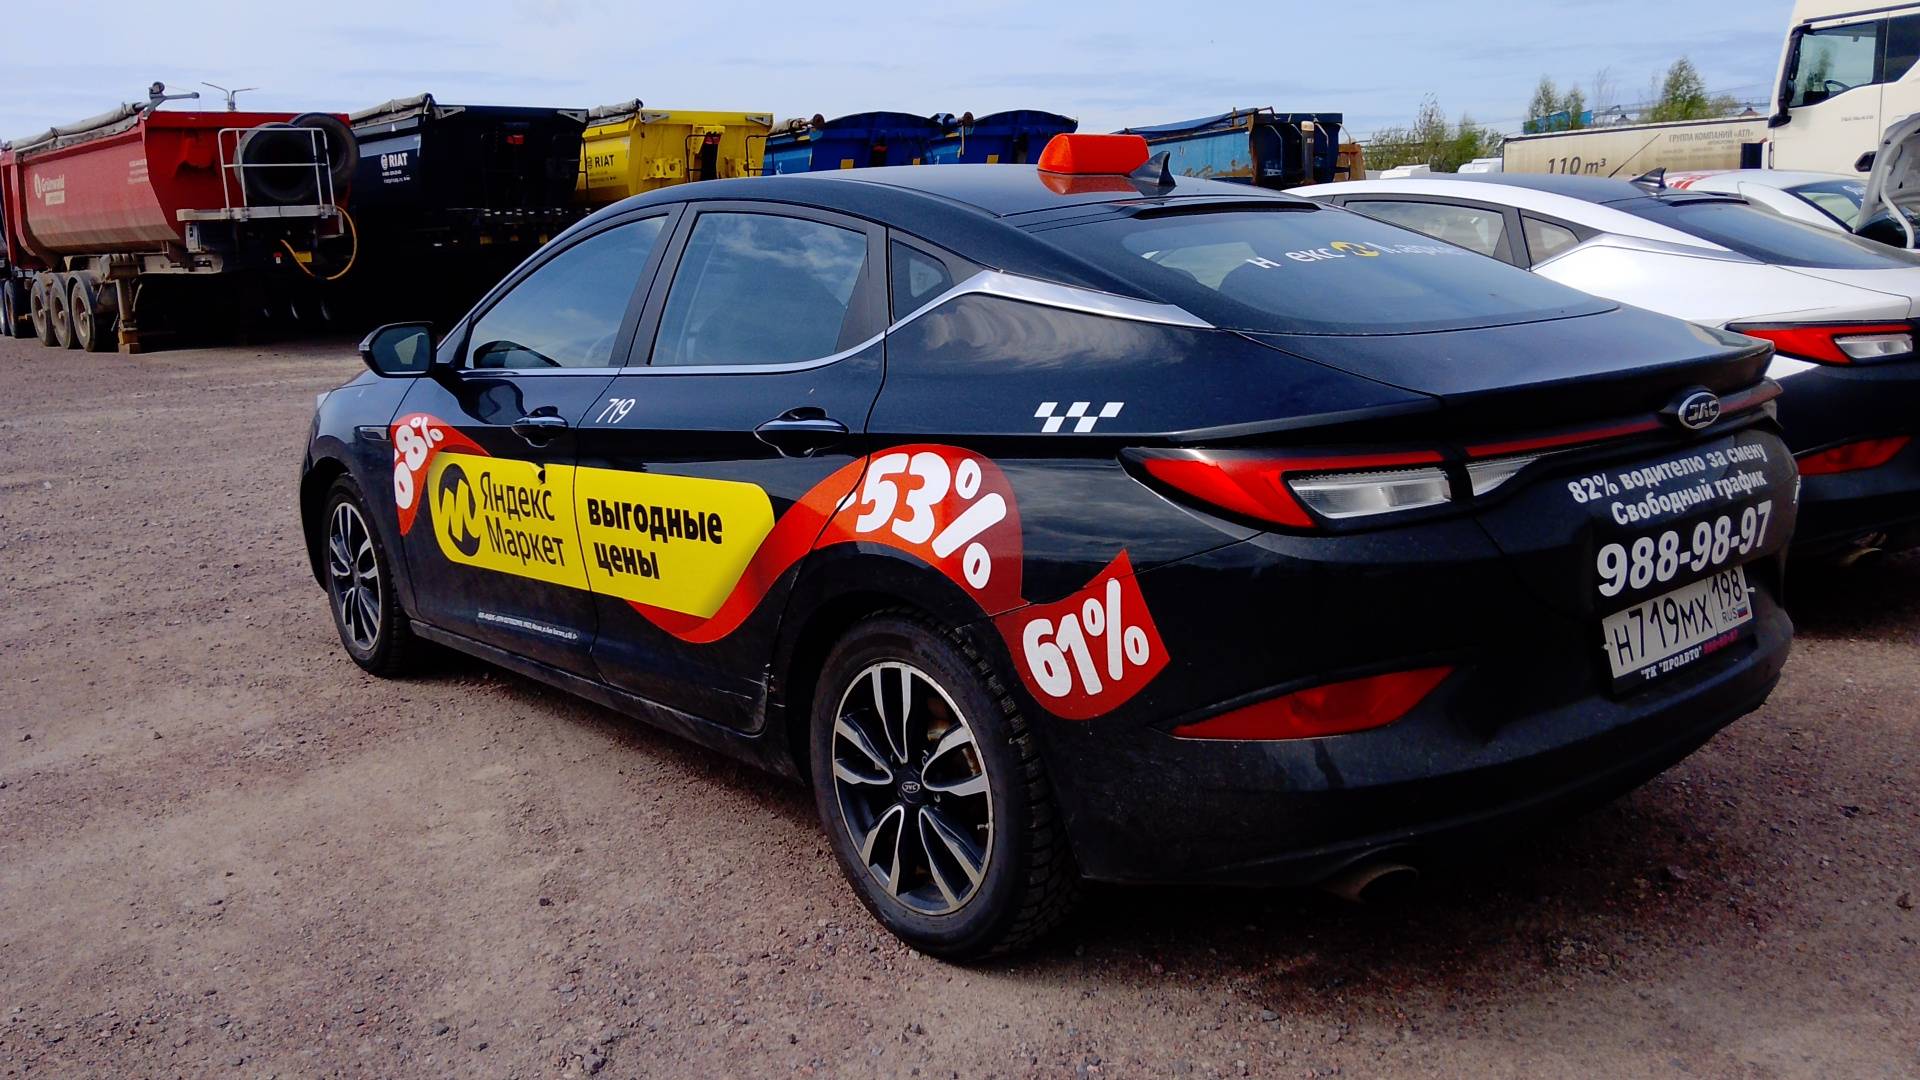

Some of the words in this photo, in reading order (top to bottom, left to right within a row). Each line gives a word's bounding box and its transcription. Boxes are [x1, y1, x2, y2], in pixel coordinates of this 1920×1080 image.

[389, 153, 408, 168] RIAT
[594, 154, 614, 168] RIAT
[1548, 156, 1582, 175] 110
[595, 398, 636, 424] 719
[480, 471, 555, 522] Яндекс
[1568, 473, 1620, 504] 82%
[1618, 455, 1706, 490] водителю
[1706, 452, 1728, 468] за
[1726, 443, 1768, 464] смену
[1611, 477, 1715, 525] Свободный
[1713, 469, 1768, 500] график
[485, 514, 566, 567] Маркет
[586, 498, 723, 545] выгодные
[593, 542, 660, 580] цены
[1597, 500, 1773, 597] 988-98-97
[1022, 577, 1150, 697] 61%
[1613, 595, 1713, 667] Н719МХ
[1711, 568, 1743, 610] 198
[1721, 607, 1738, 624] RUS
